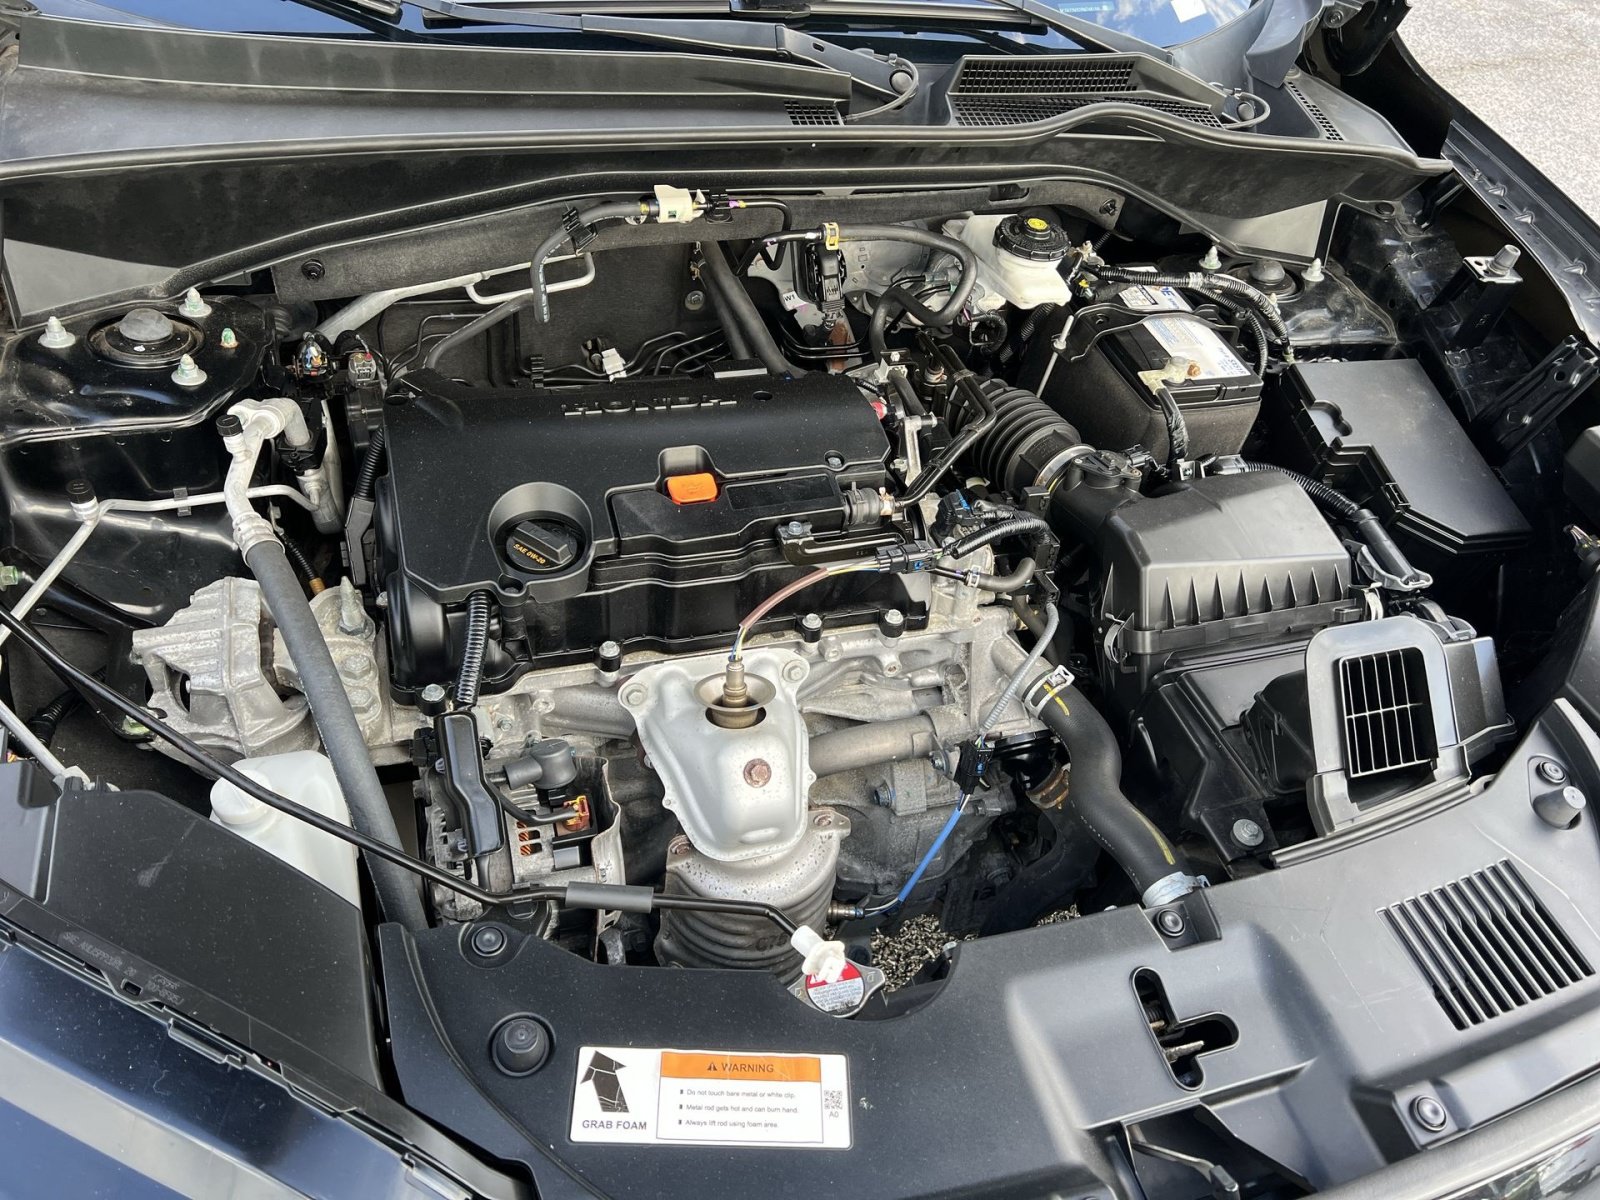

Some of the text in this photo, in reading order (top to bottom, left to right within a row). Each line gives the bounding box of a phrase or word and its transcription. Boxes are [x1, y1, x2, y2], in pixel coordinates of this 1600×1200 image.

[784, 294, 796, 302] W1
[513, 543, 546, 564] SAE 0W-20
[721, 1062, 775, 1074] WARNING
[686, 1088, 696, 1096] Do
[582, 1119, 648, 1131] GRAB FOAM
[685, 1119, 708, 1128] Always
[729, 1121, 746, 1129] using
